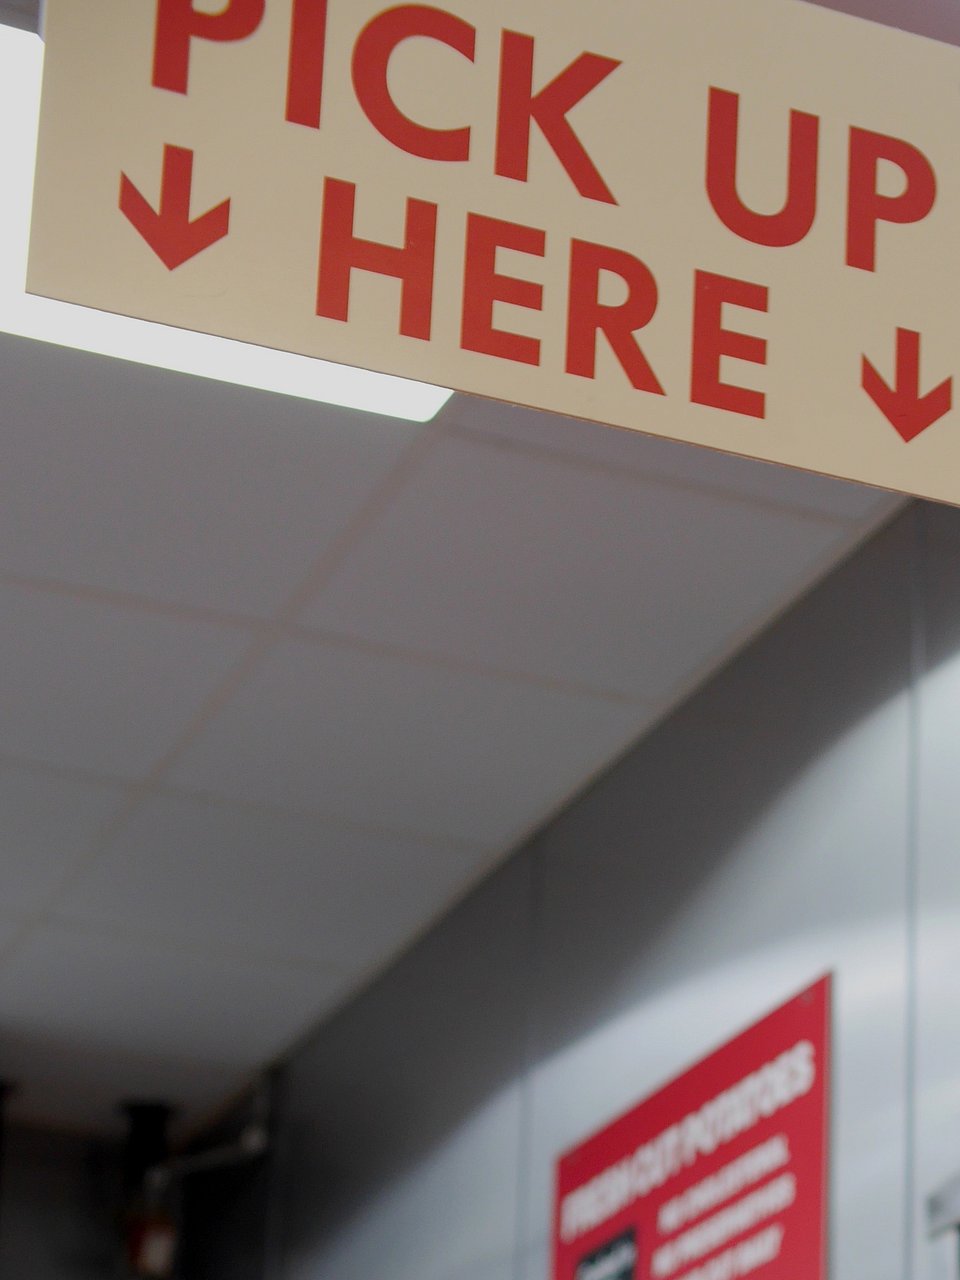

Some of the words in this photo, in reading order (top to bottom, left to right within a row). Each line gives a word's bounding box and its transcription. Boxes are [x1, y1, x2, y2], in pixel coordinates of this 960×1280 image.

[152, 0, 621, 206] PICK
[705, 85, 937, 273] UP
[315, 177, 769, 420] HERE
